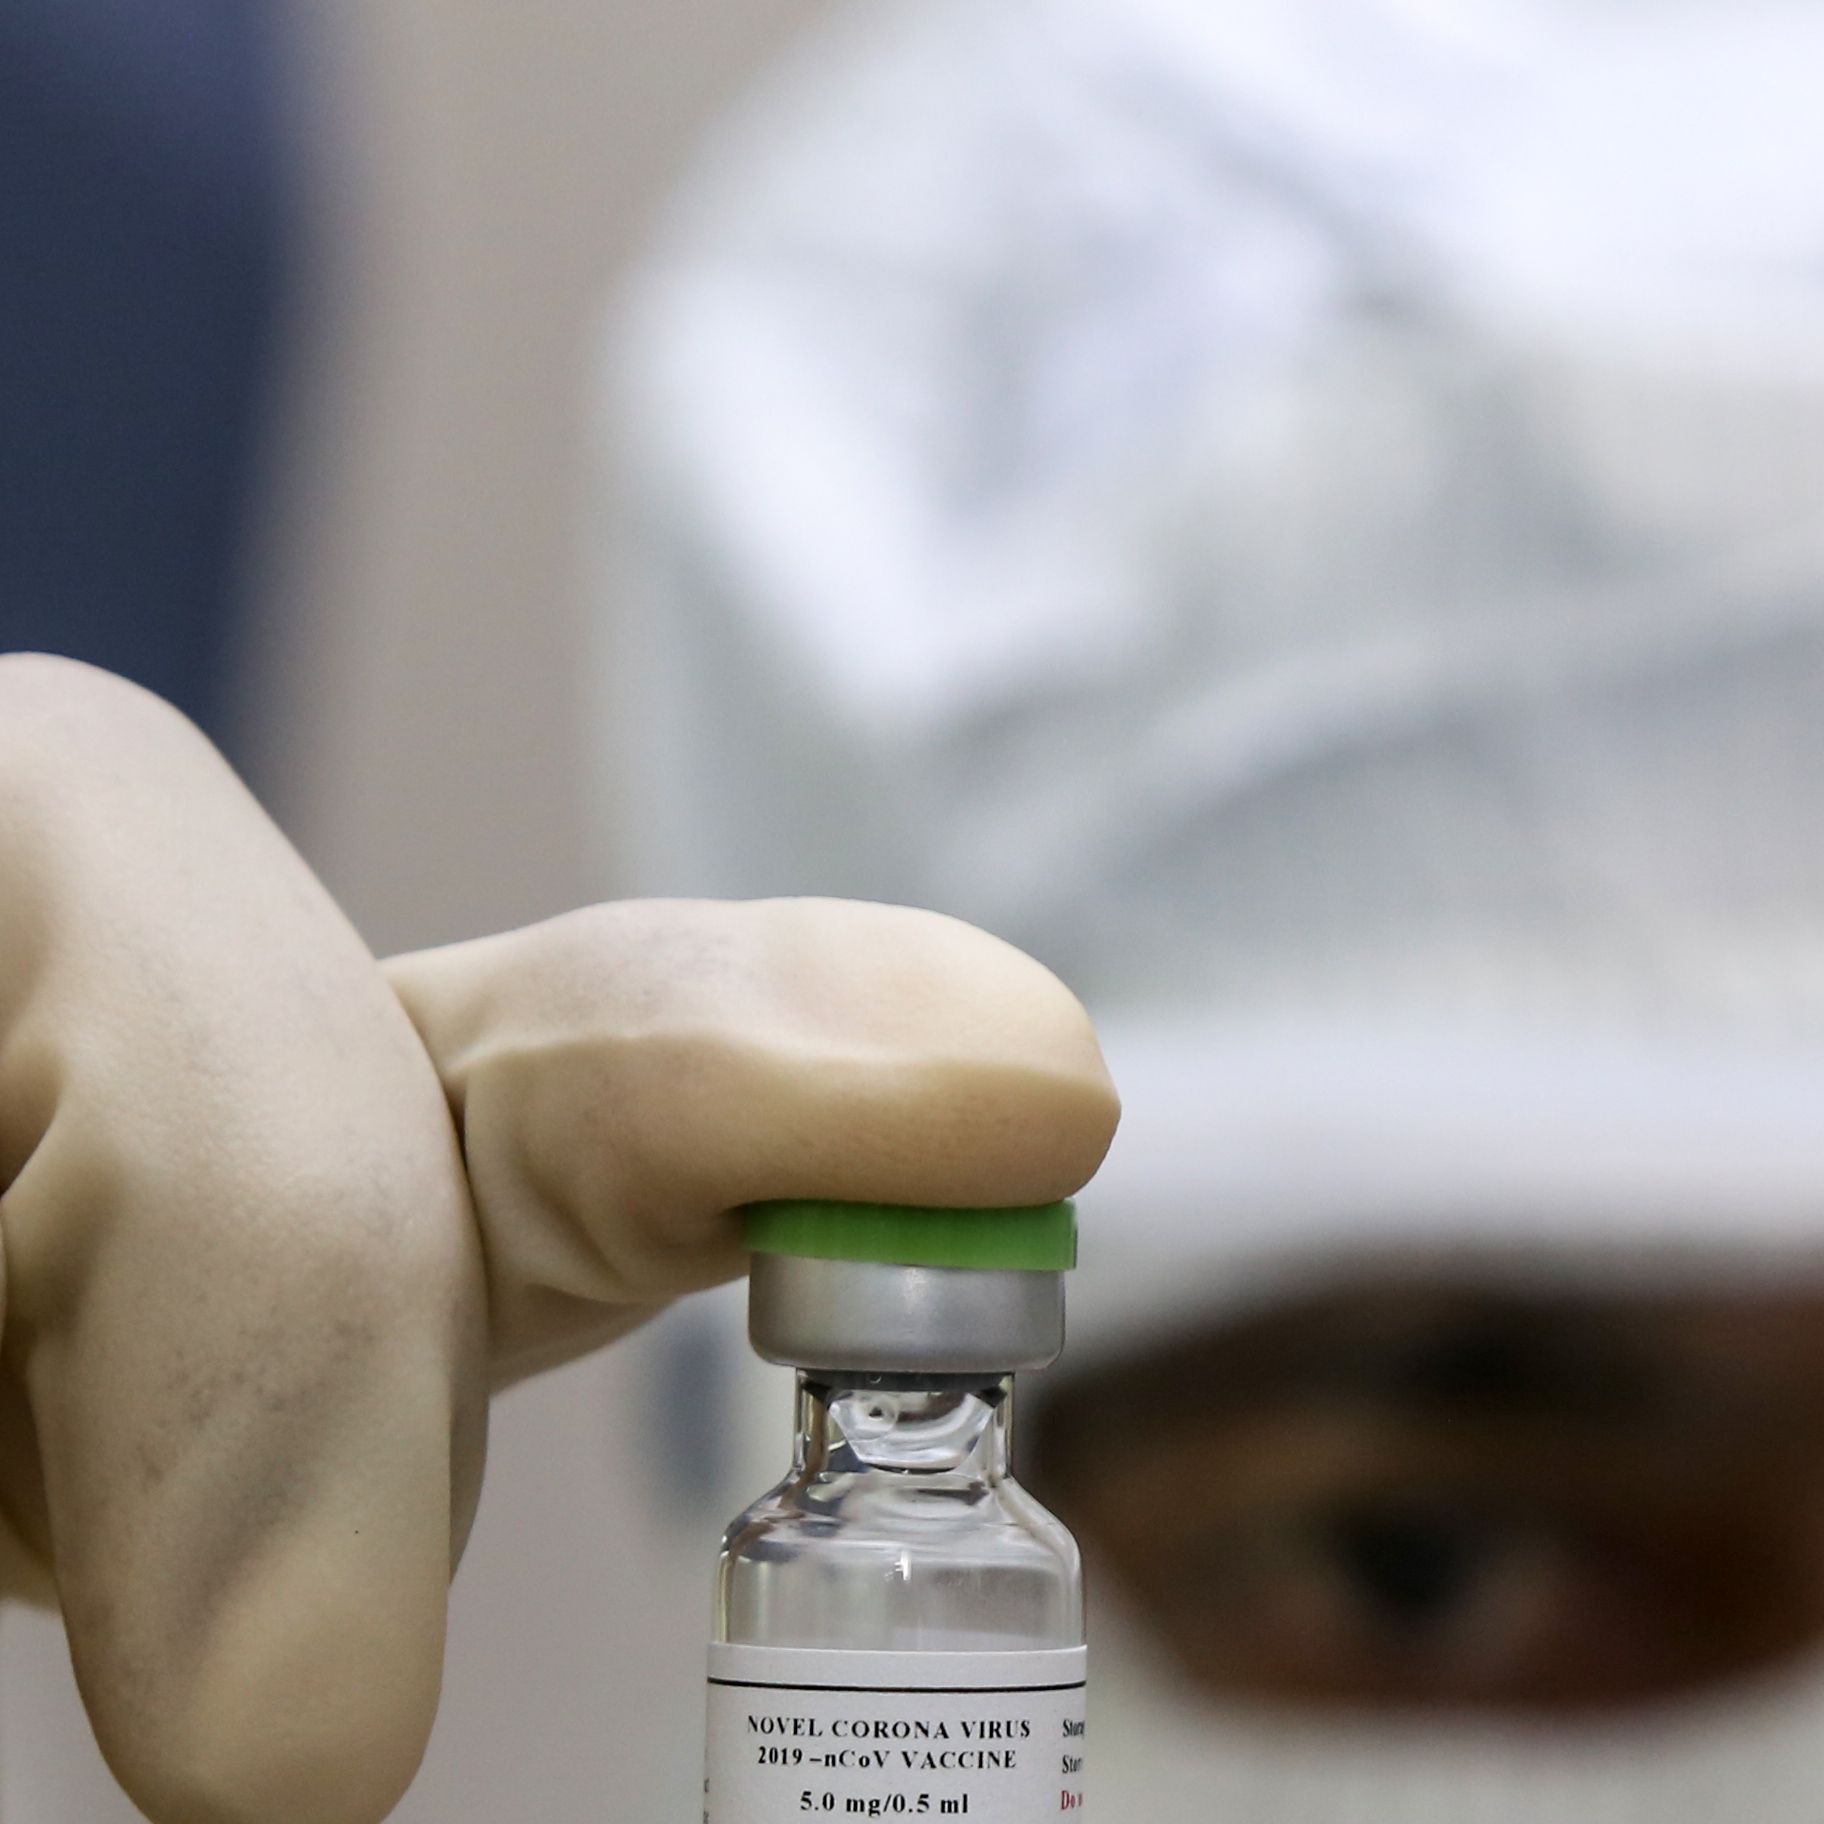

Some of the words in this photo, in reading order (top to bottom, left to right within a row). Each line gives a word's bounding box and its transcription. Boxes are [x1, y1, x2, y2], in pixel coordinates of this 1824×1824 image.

[746, 1715, 823, 1737] NOVEL
[831, 1720, 950, 1739] CORONA
[960, 1719, 1030, 1740] VIRUS
[757, 1745, 803, 1766] 2019
[901, 1750, 1016, 1770] VACCINE
[800, 1790, 835, 1812] 5.0
[846, 1793, 930, 1819] mg/0.5
[940, 1793, 968, 1814] ml
